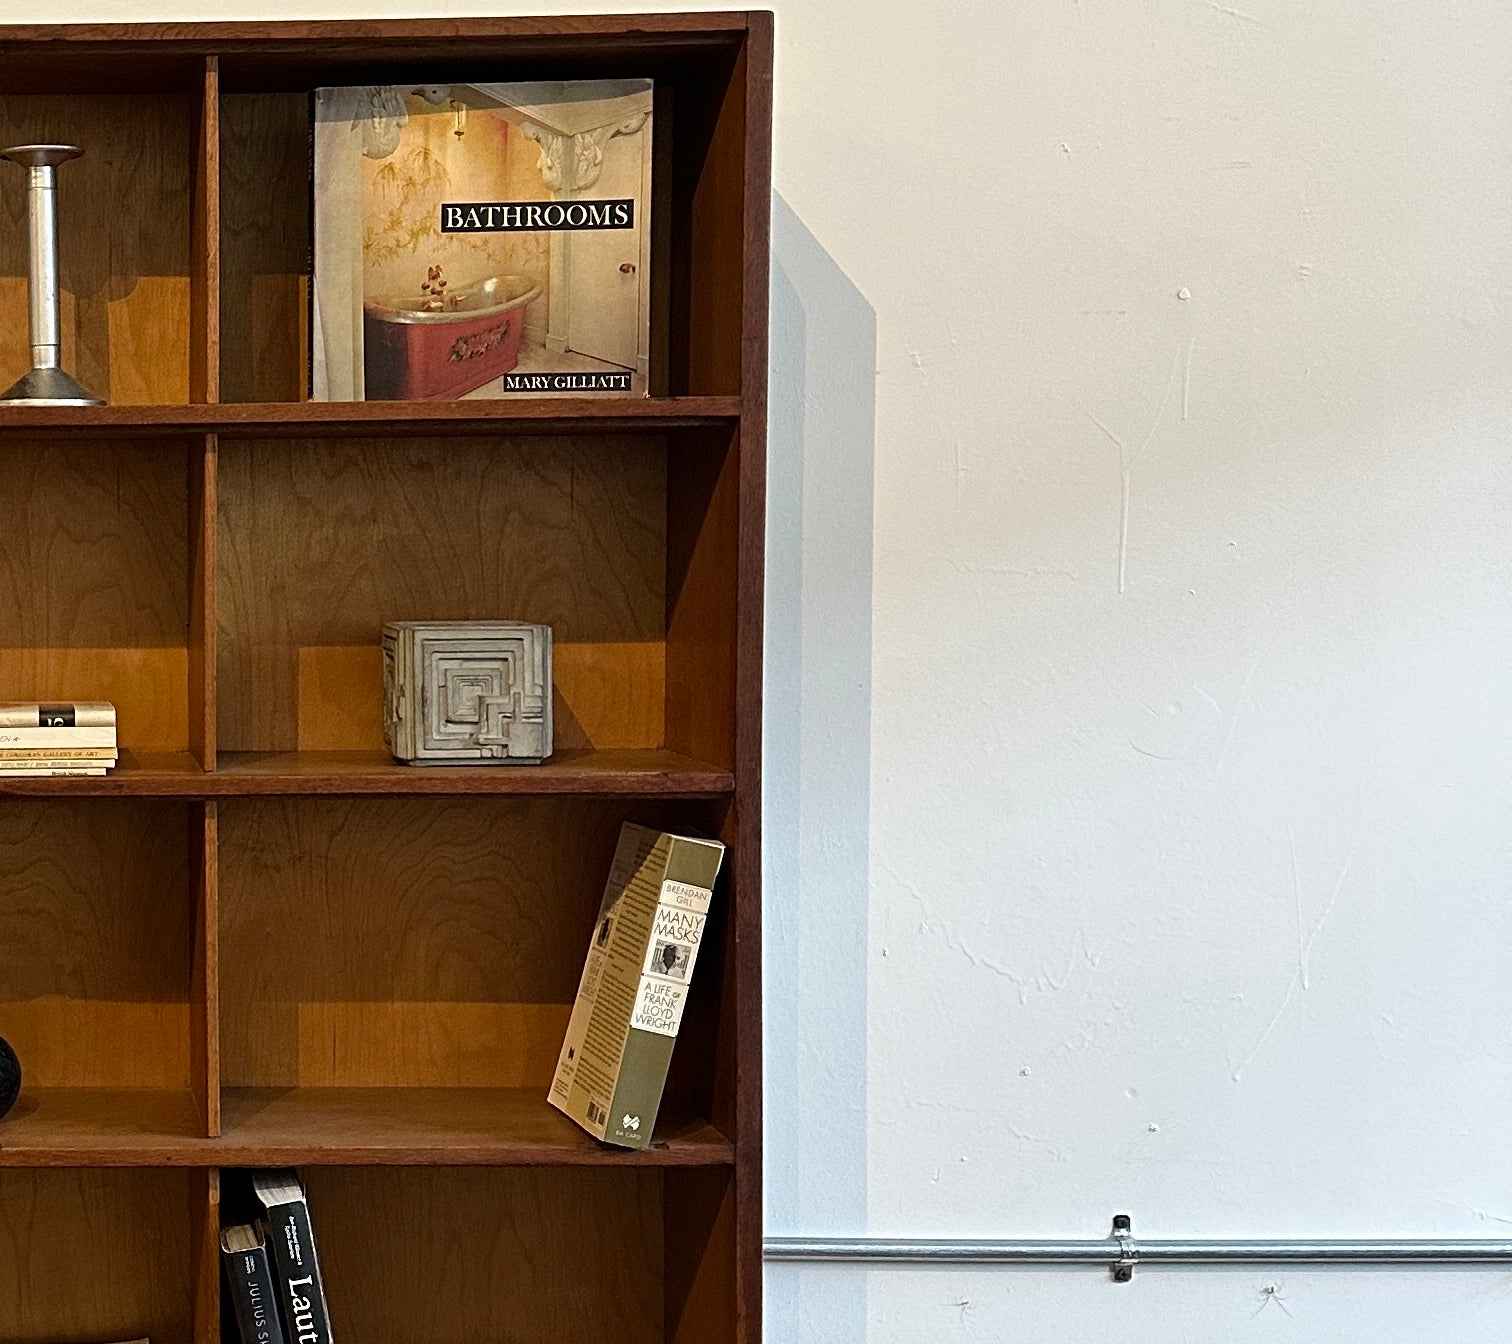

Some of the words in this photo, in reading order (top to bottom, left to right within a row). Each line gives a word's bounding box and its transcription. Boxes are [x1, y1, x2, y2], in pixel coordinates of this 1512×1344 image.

[445, 203, 629, 229] BATHROOMS
[506, 376, 551, 389] MARY
[554, 375, 630, 388] GILLIATT
[666, 884, 708, 901] BRENDAN
[656, 908, 704, 929] MANY
[653, 922, 701, 945] MASKS
[644, 982, 652, 994] A
[654, 983, 671, 997] LIFE
[644, 992, 679, 1010] FRANK
[642, 1004, 674, 1020] LLOYD
[635, 1013, 678, 1033] WRIGHT
[248, 1281, 266, 1327] JULIUS
